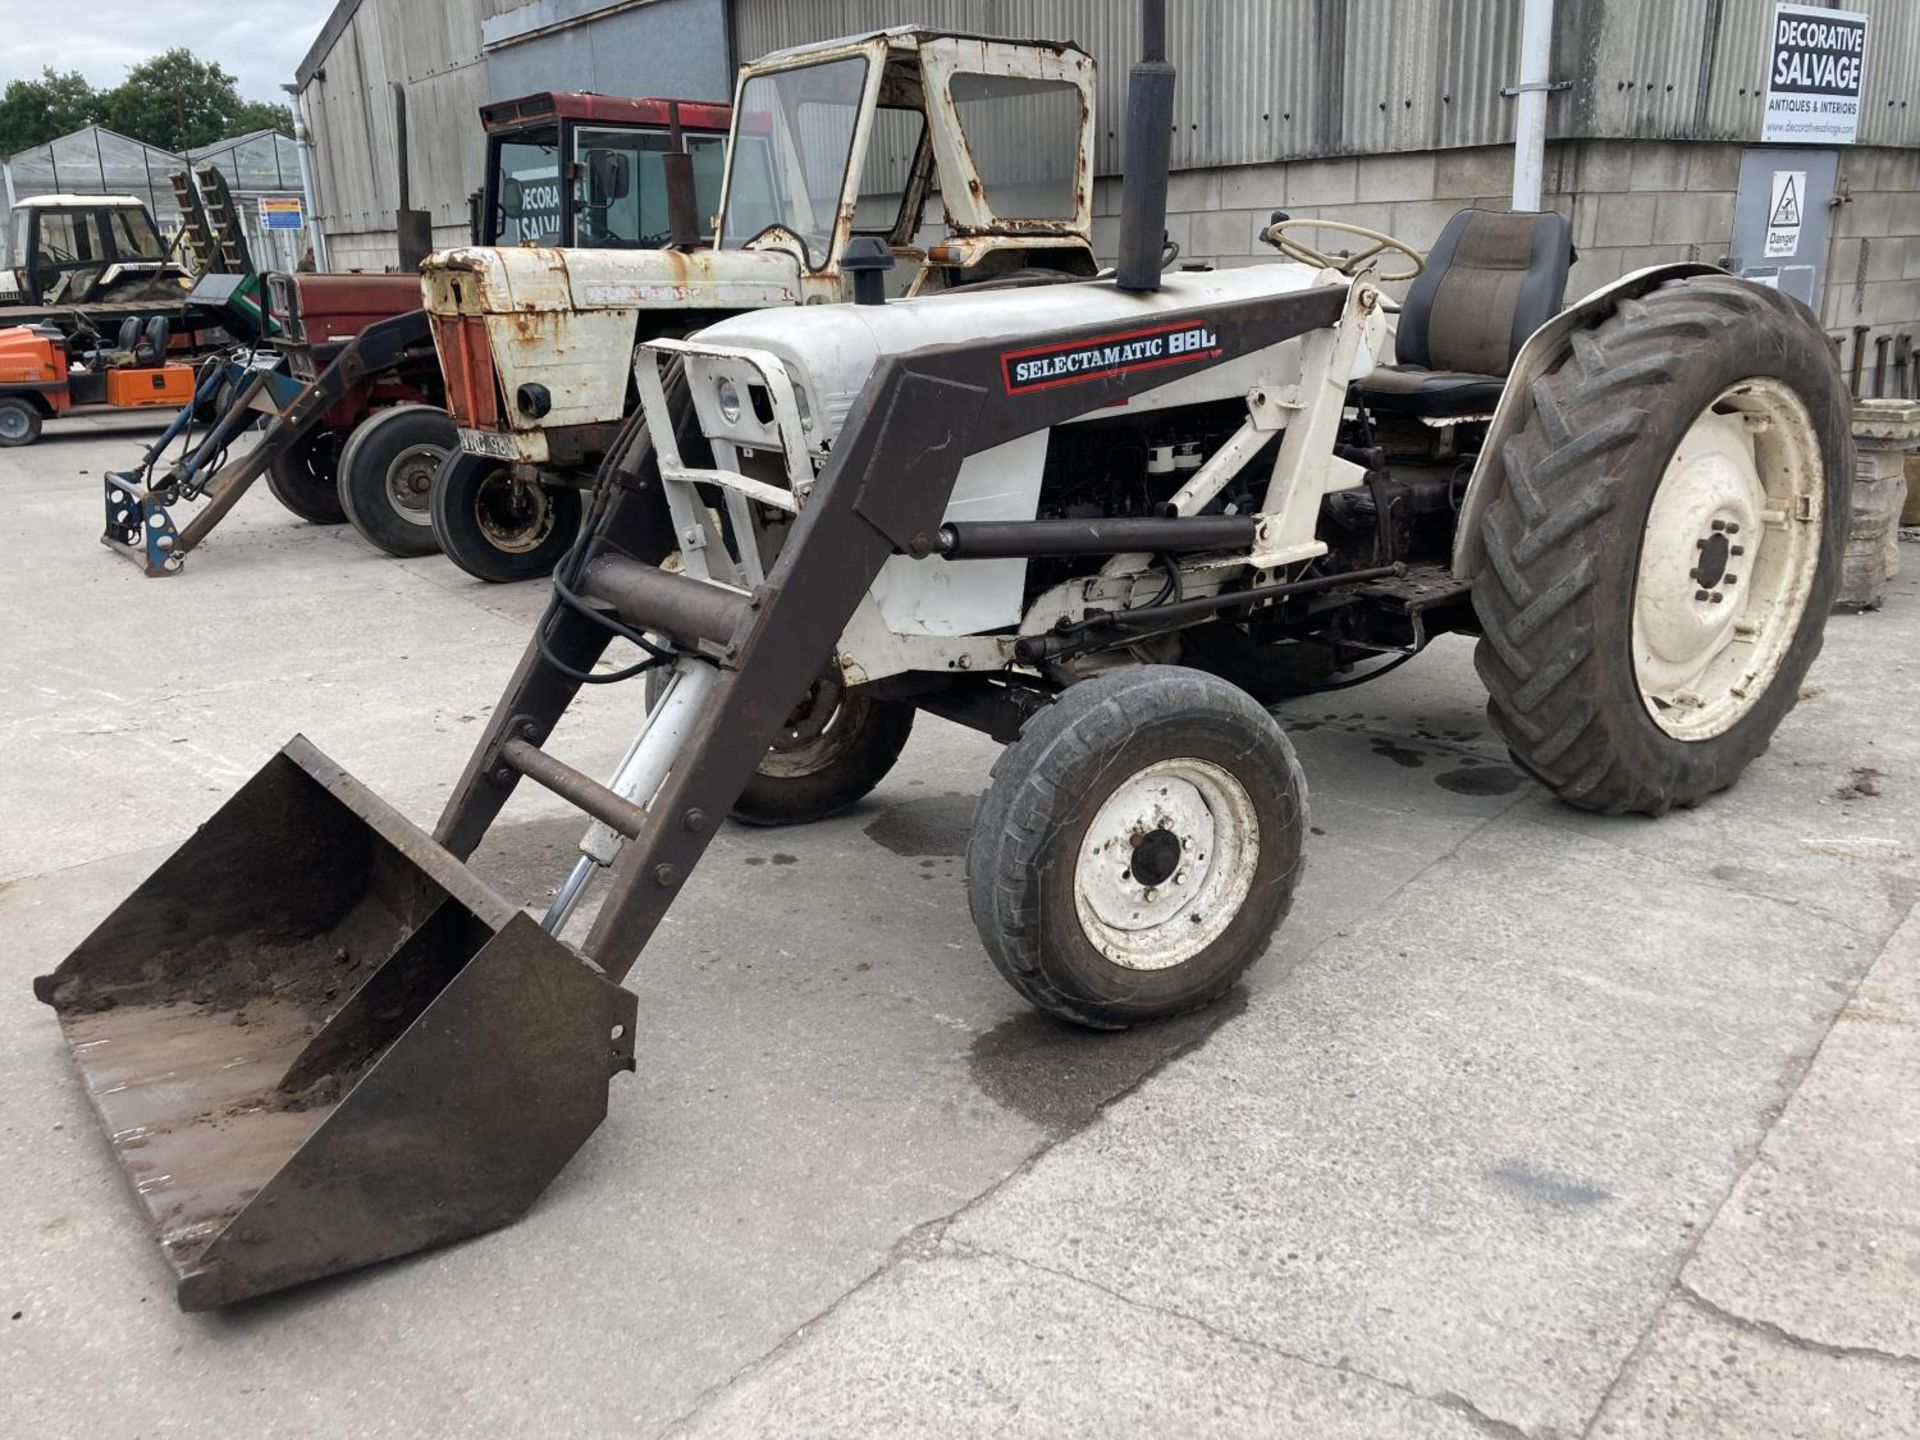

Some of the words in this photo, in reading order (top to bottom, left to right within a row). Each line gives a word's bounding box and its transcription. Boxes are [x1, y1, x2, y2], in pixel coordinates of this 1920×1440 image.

[1778, 20, 1862, 52] DECORATIVE
[1774, 51, 1860, 89] SALVAGE
[1769, 98, 1811, 113] ANTIQUES
[1812, 101, 1819, 112] &
[1820, 101, 1857, 115] INTERIORS
[1770, 232, 1796, 246] Danger
[1016, 339, 1162, 381] SELECTAMATIC
